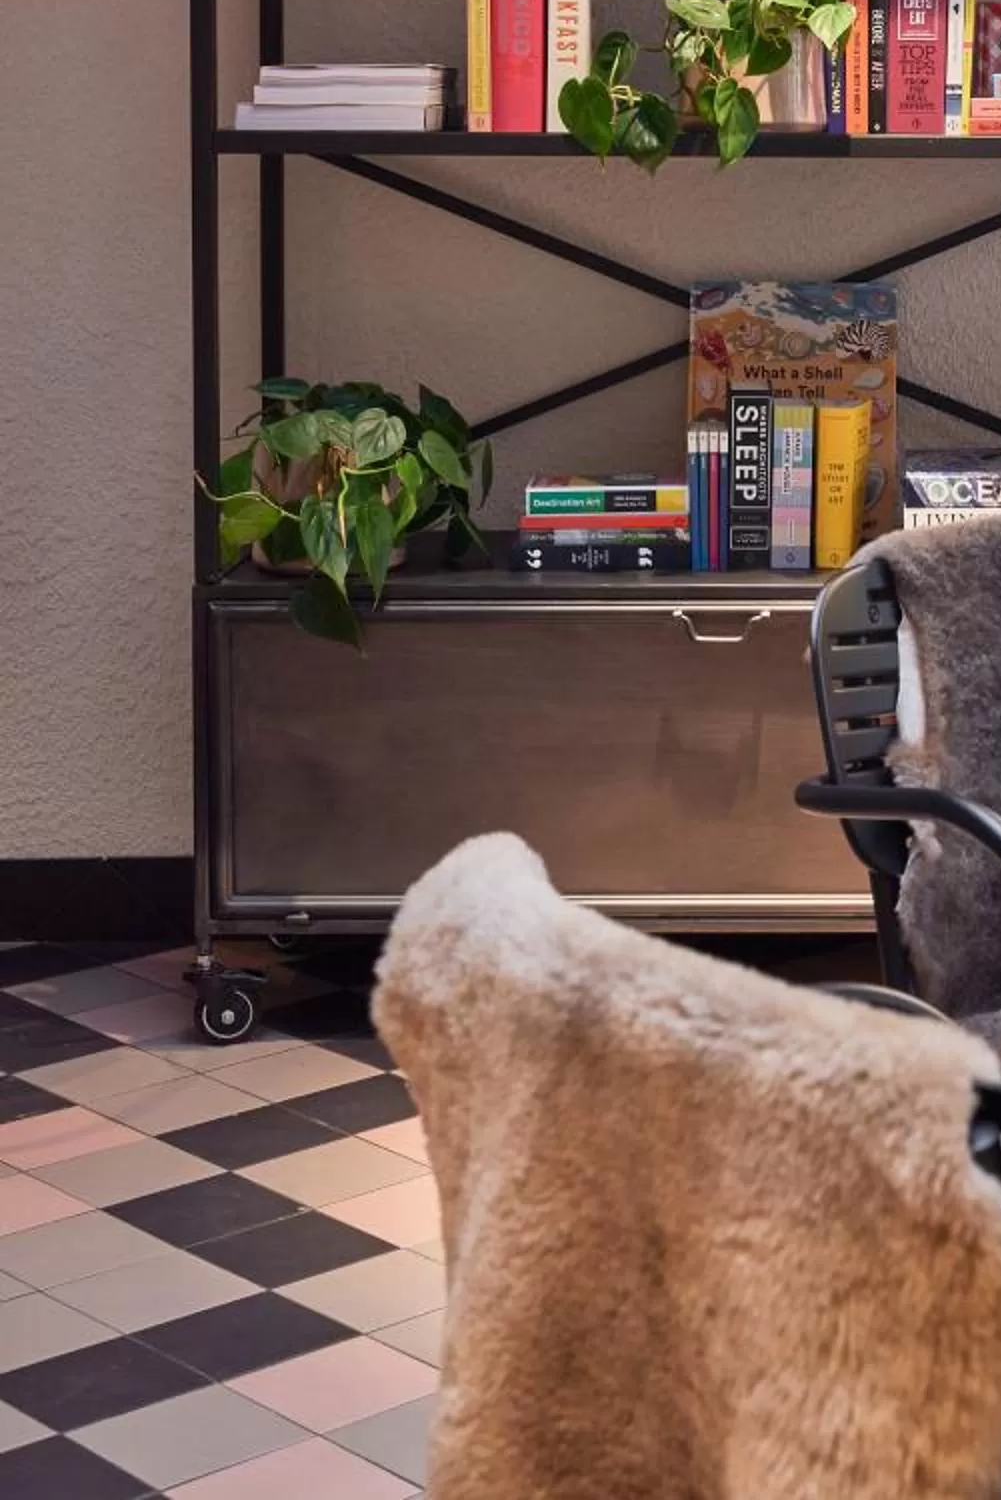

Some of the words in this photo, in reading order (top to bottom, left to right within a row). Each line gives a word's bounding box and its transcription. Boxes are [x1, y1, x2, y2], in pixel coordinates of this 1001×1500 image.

[909, 10, 926, 25] EAT
[899, 45, 936, 60] TOP
[743, 364, 787, 380] What
[791, 369, 800, 380] a
[804, 365, 843, 380] Shell
[798, 385, 826, 399] Tell
[735, 405, 759, 501] SLEEP
